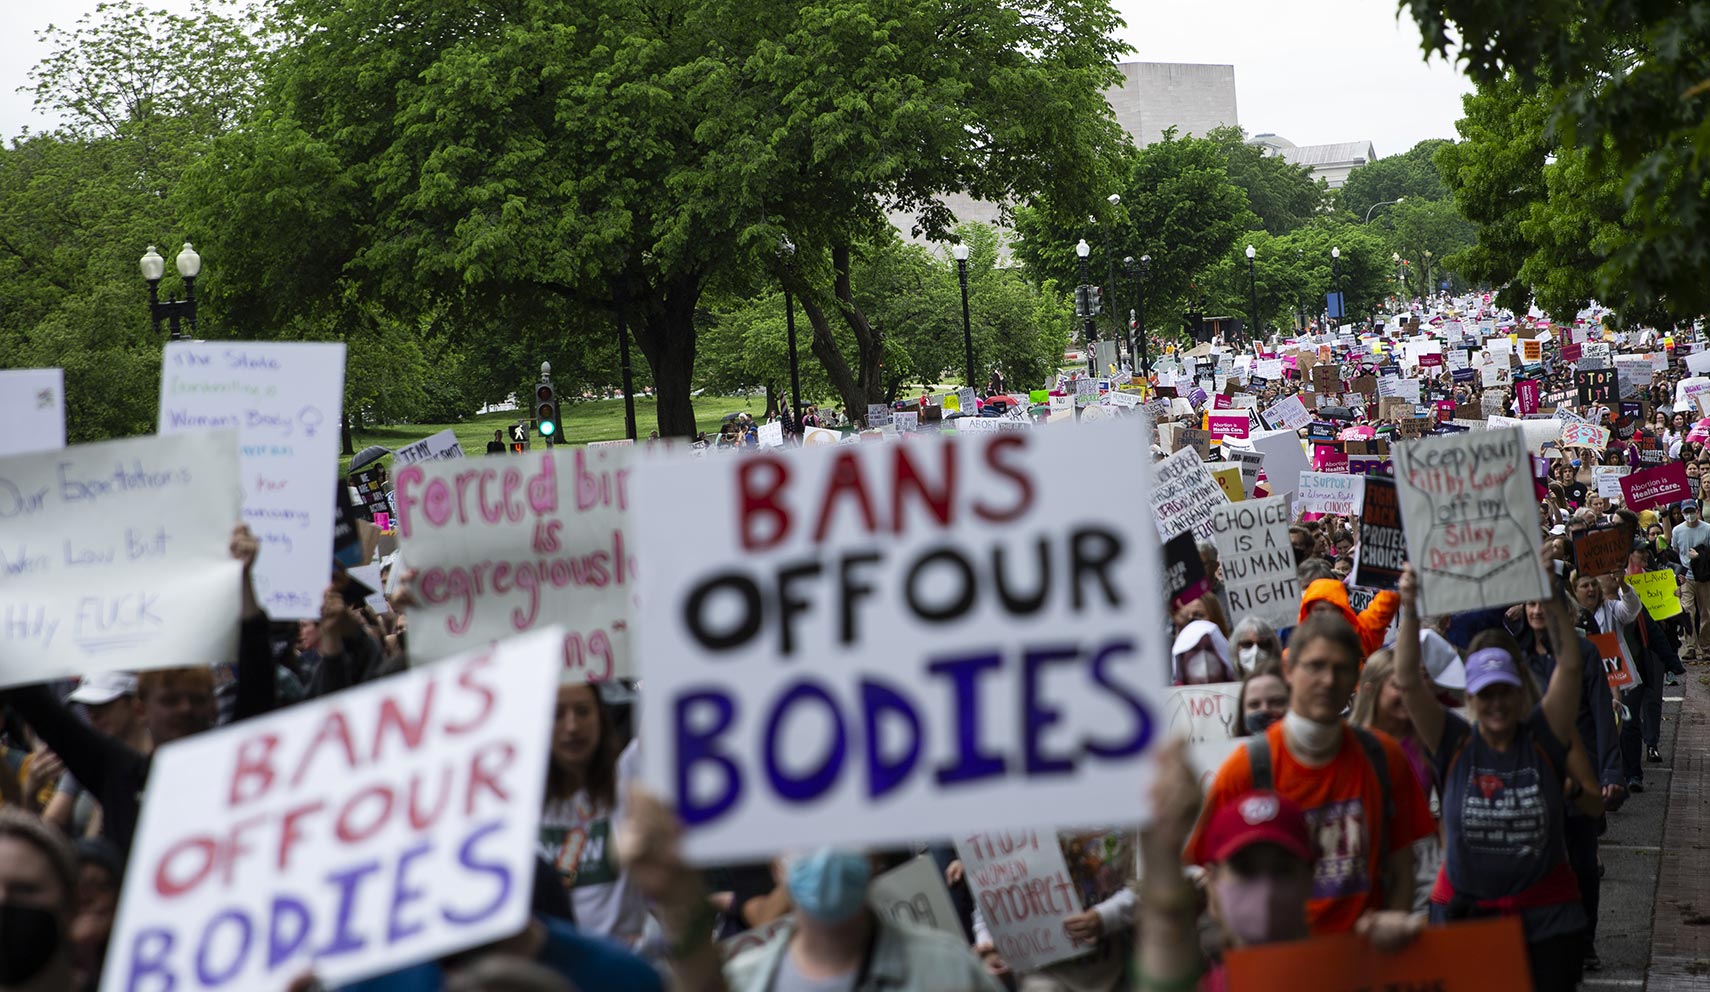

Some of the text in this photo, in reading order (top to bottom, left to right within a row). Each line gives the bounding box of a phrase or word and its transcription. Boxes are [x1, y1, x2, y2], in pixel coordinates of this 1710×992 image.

[1578, 372, 1613, 385] STOP
[1588, 386, 1609, 401] IT!
[1407, 441, 1466, 477] Keep
[1641, 449, 1664, 457] PROTECT
[735, 434, 1038, 552] BANS
[1300, 475, 1353, 489] I SUPPORT
[1367, 484, 1399, 504] FIGH
[1631, 480, 1660, 493] Abortion
[1633, 482, 1680, 500] Health Care.
[1213, 503, 1287, 534] CHOICE
[1324, 501, 1352, 513] CHOOSE
[534, 518, 562, 552] is
[1235, 530, 1276, 552] IS A
[1362, 524, 1407, 549] PROTEC
[1222, 550, 1291, 581] HUMAN
[1430, 544, 1511, 570] Drawers
[684, 552, 886, 656] OFF
[904, 525, 1125, 625] OUR
[1627, 572, 1668, 585] Your LAWS
[1229, 578, 1298, 612] RIGHT
[74, 592, 163, 637] FUCK
[1190, 694, 1224, 718] NOT
[226, 655, 496, 808] BANS
[672, 639, 1155, 828] BODIES
[152, 742, 519, 898] OFF OUR
[126, 821, 515, 992] BODIES
